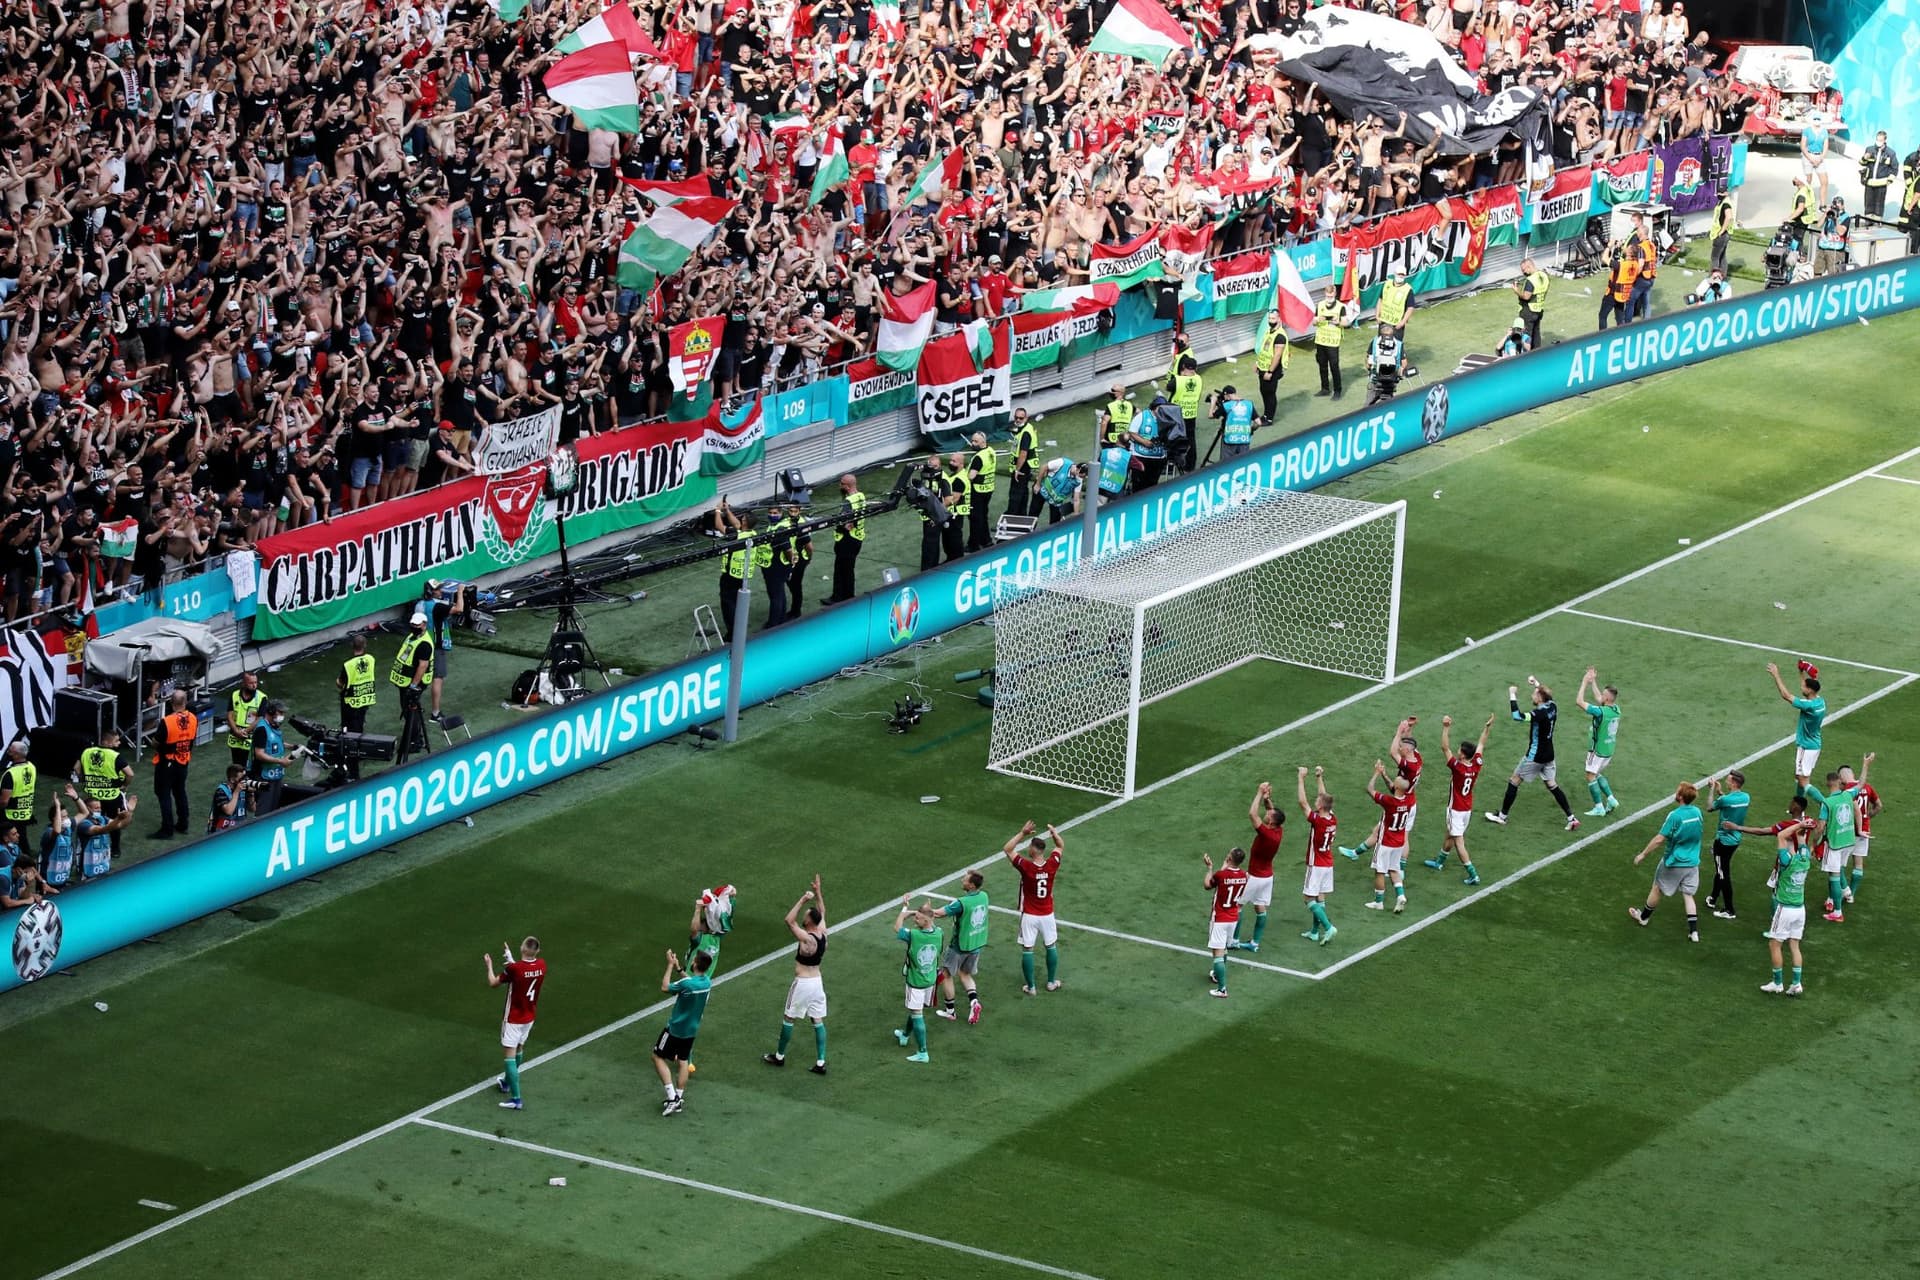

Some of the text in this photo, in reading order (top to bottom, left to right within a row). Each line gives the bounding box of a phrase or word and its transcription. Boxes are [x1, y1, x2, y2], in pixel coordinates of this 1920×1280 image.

[1357, 221, 1467, 290] JPEST
[1567, 269, 1907, 387] AT EURO2020.COM/STORE
[783, 399, 805, 420] 109
[955, 556, 1008, 613] GET
[1140, 462, 1261, 541] LICENSED
[1271, 411, 1396, 492] PRODUCTS
[267, 499, 480, 614] CARPATHIAN
[174, 591, 201, 615] 110
[265, 664, 723, 877] AT EURO2020.COM/STORE
[1462, 777, 1472, 797] 8
[1388, 811, 1409, 832] 10
[1037, 879, 1048, 899] 6
[526, 978, 537, 1002] 4
